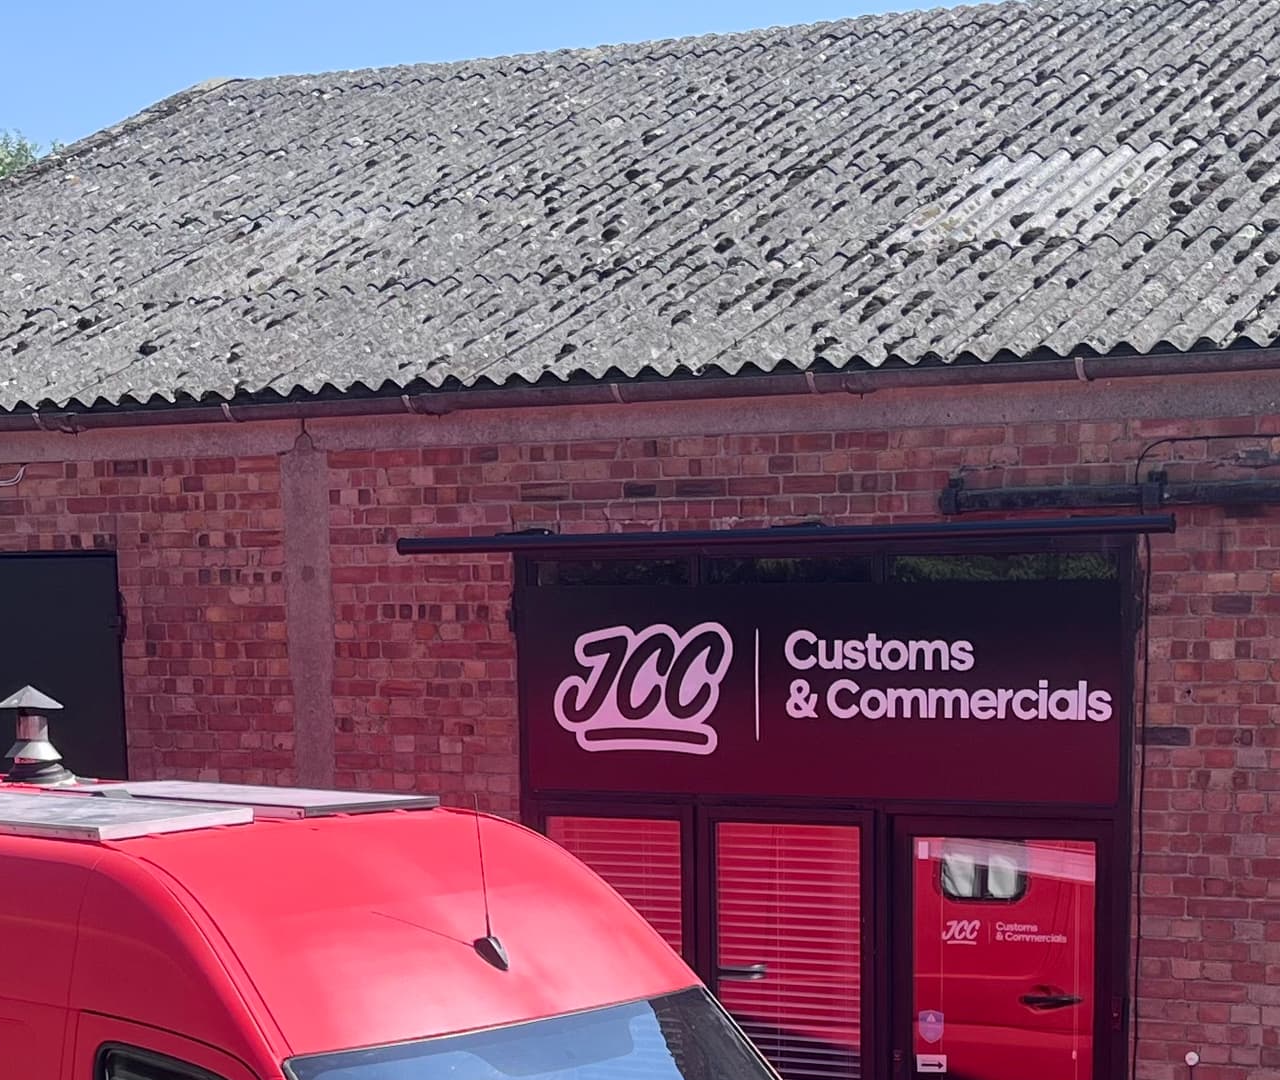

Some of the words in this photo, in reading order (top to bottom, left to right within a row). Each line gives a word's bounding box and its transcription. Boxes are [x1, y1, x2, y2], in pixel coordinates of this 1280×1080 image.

[784, 629, 975, 671] Customs
[556, 624, 730, 738] JCC
[785, 678, 819, 719] &
[826, 678, 1113, 721] Commercials
[942, 920, 980, 940] JCC
[995, 922, 1038, 932] Customs
[1004, 932, 1067, 943] Commercials
